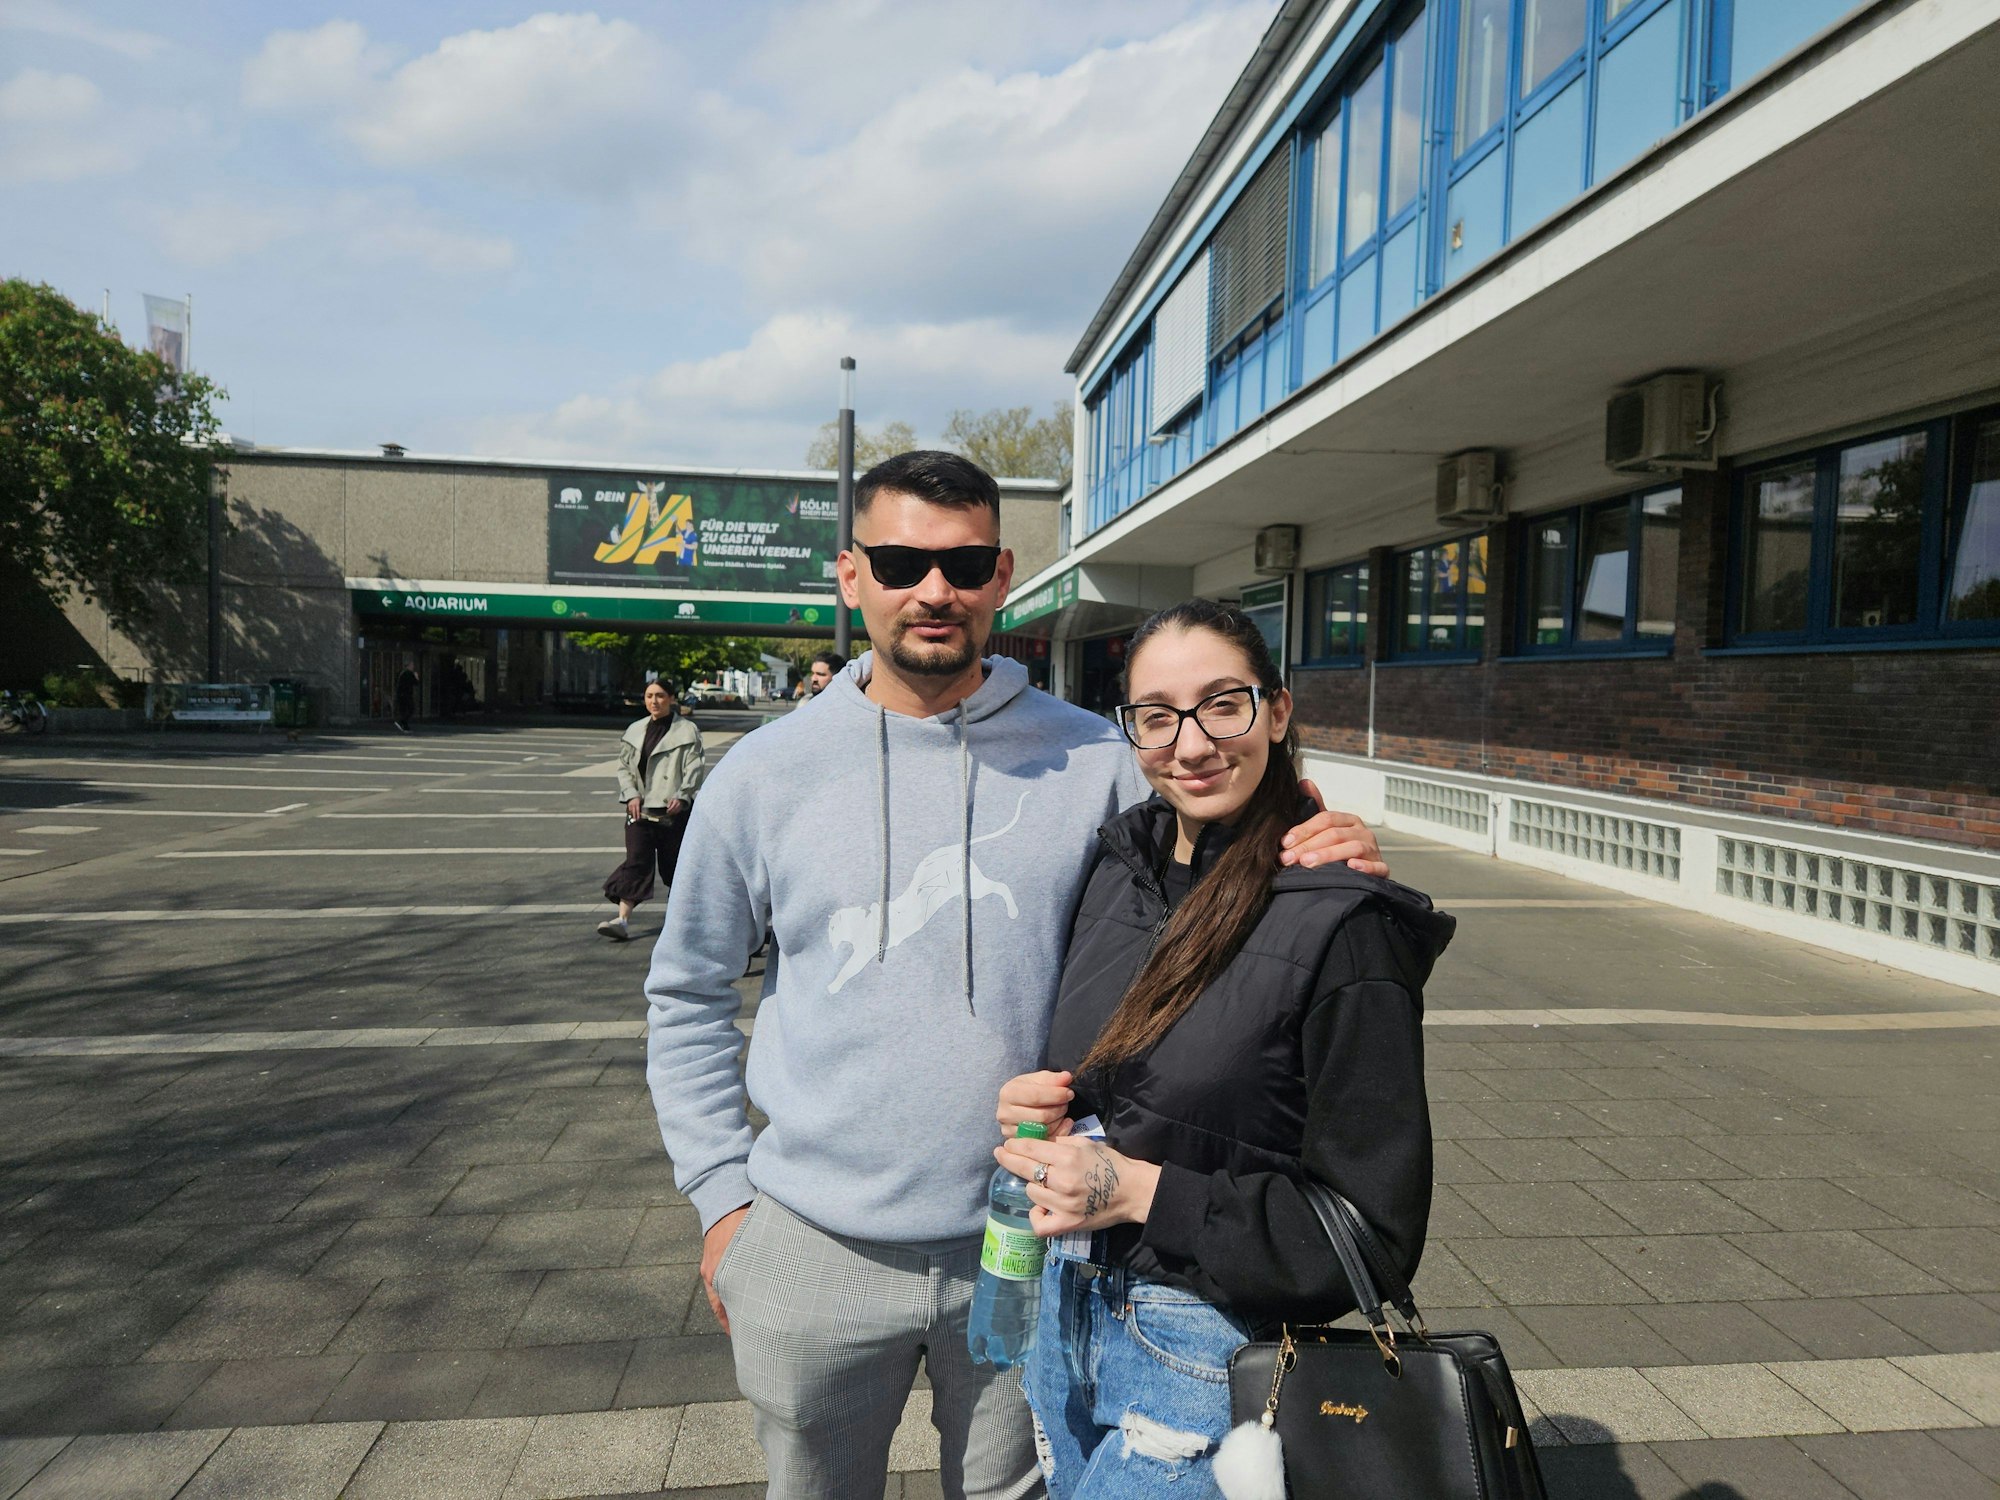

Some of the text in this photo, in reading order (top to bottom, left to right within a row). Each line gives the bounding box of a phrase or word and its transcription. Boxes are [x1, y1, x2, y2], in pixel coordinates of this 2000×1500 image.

[595, 490, 626, 503] DEIN
[800, 499, 830, 510] KÖLN
[593, 492, 698, 566] JA
[699, 518, 780, 534] FÜR DIE WELT
[701, 532, 766, 545] ZU GAST IN
[702, 544, 811, 558] UNSEREN VEEDELN
[404, 595, 488, 611] AQUARIUM
